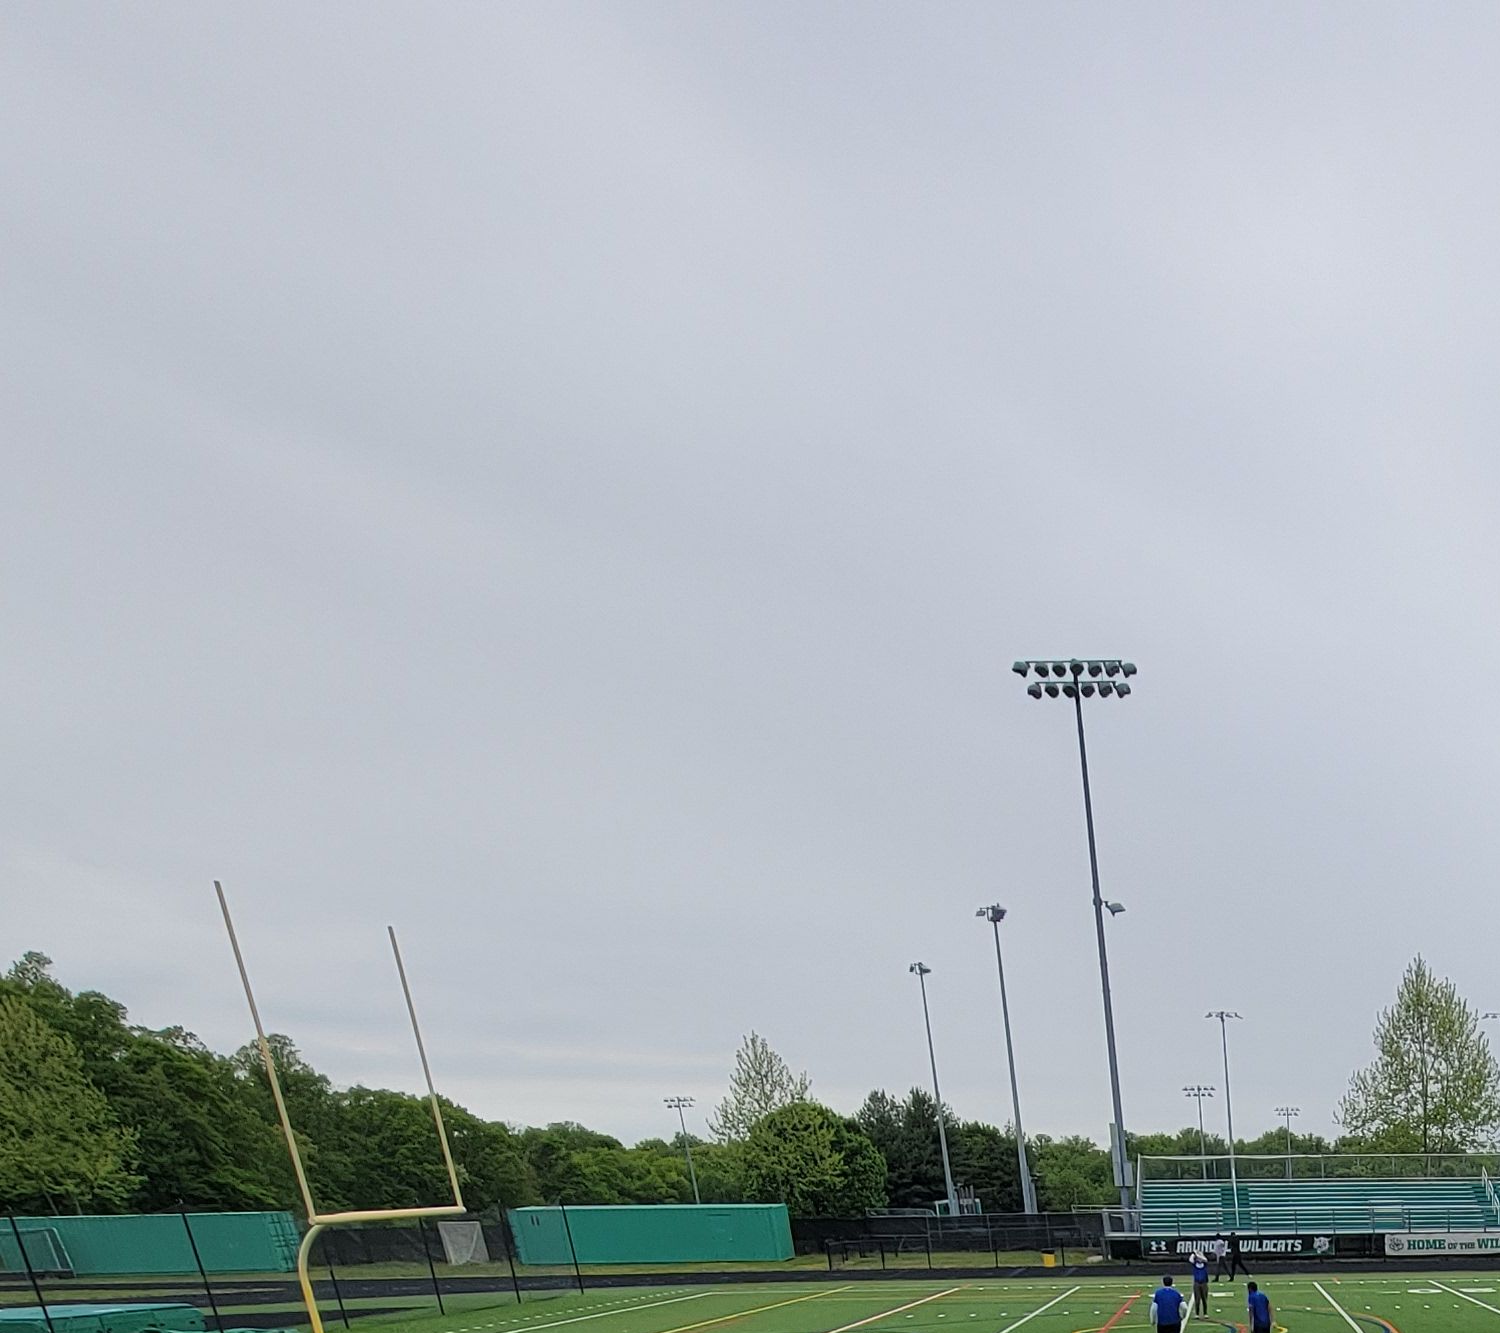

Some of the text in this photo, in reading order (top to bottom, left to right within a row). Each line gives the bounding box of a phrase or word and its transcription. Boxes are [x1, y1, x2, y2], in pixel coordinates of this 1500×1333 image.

[1176, 1240, 1303, 1253] ARUNDL WILDCATS
[1407, 1239, 1446, 1250] HOME
